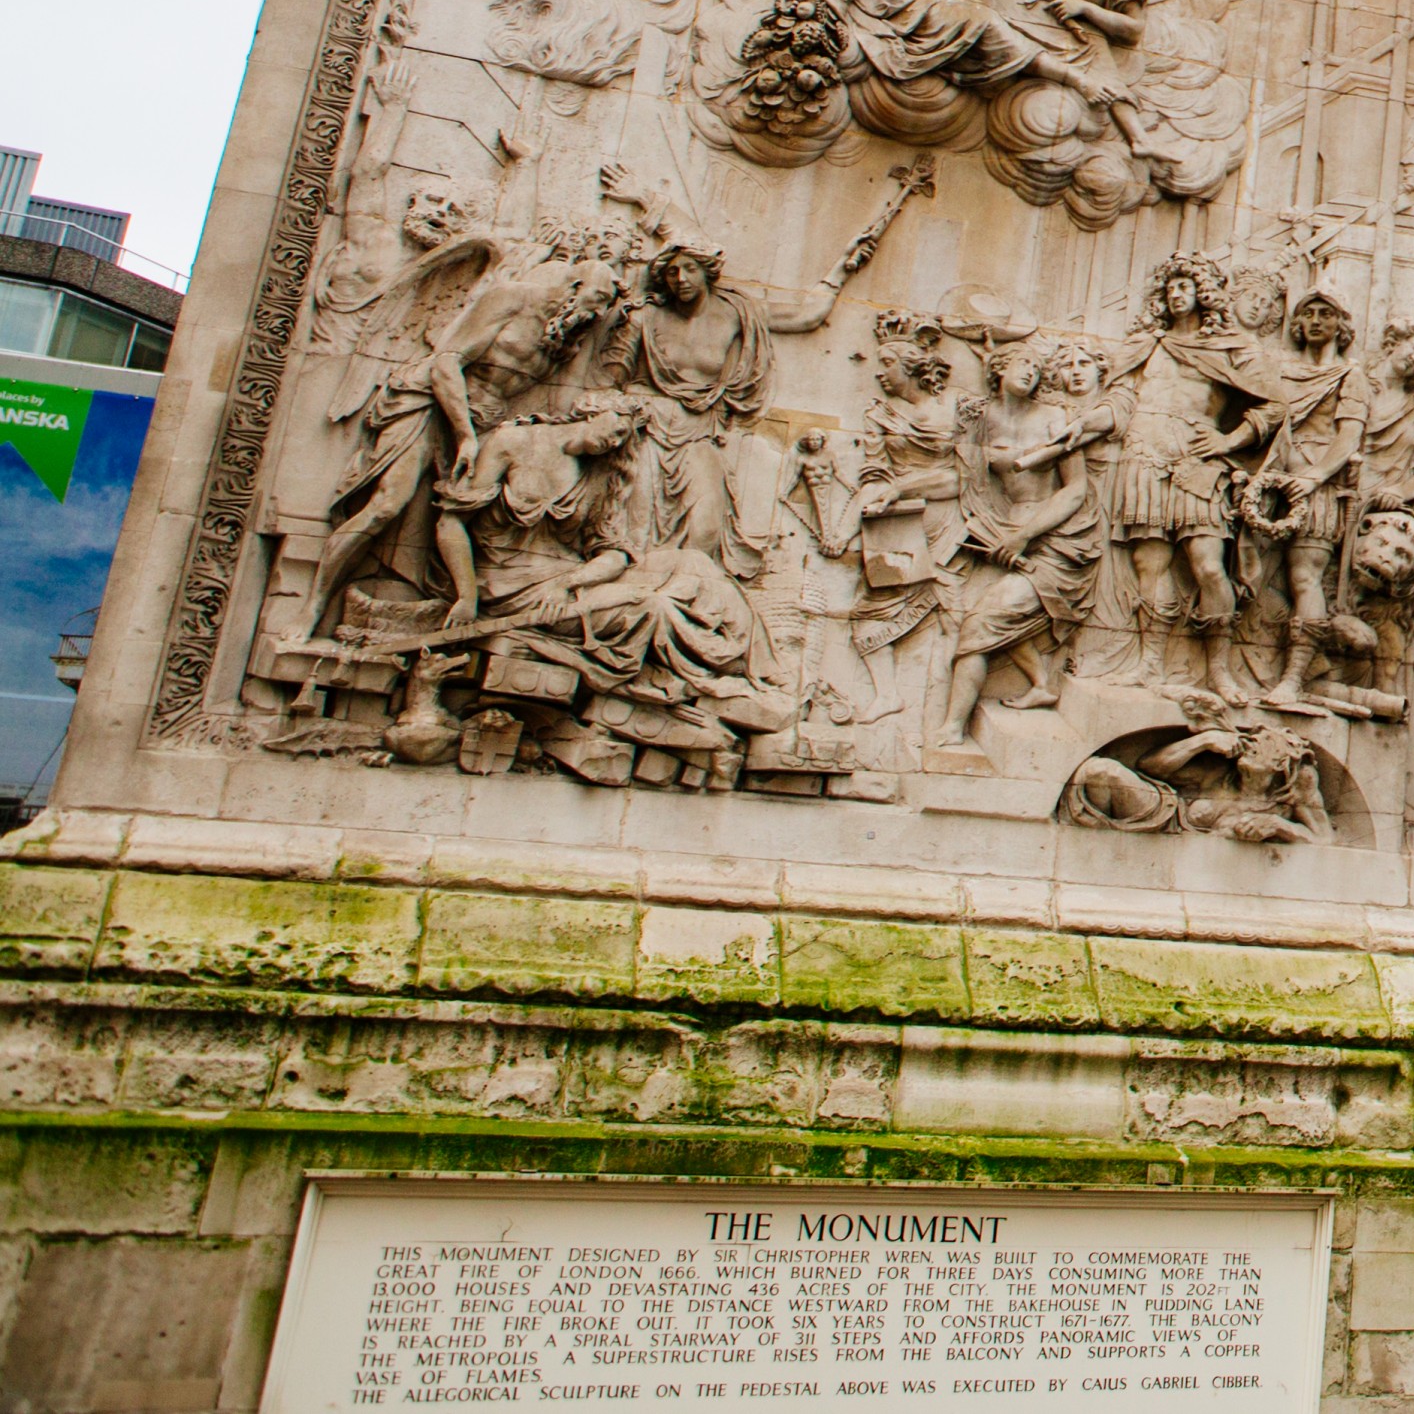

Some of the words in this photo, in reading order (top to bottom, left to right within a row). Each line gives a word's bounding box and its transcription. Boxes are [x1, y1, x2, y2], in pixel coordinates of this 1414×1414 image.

[30, 395, 45, 407] by
[706, 1212, 774, 1241] THE
[796, 1213, 1008, 1244] MONUMENT
[381, 1246, 422, 1261] THIS
[567, 1247, 661, 1263] DESIGNED
[675, 1249, 700, 1263] BY
[714, 1249, 738, 1263] SIR
[754, 1249, 870, 1264] CHRISTOPHER
[946, 1250, 981, 1265] WAS
[993, 1251, 1037, 1265] BUILT
[1052, 1251, 1074, 1265] TO
[1087, 1251, 1209, 1266] COMMEMORATE
[1223, 1252, 1251, 1265] THE
[375, 1264, 441, 1280] GREAT
[459, 1264, 500, 1279] FIRE
[517, 1264, 544, 1279] OF
[558, 1265, 643, 1280] LONDON
[715, 1265, 776, 1280] WHICH
[790, 1265, 863, 1281] BURNED
[877, 1266, 910, 1281] FOR
[926, 1266, 977, 1281] THREE
[992, 1266, 1034, 1281] DAYS
[1047, 1266, 1147, 1281] CONSUMING
[1160, 1267, 1205, 1281] MORE
[1218, 1267, 1262, 1281] THAN
[454, 1281, 531, 1296] HOUSES
[548, 1281, 592, 1296] AND
[607, 1281, 732, 1296] DEVASTATING
[747, 1282, 780, 1296] 436
[795, 1283, 851, 1297] ACRES
[866, 1283, 889, 1297] OF
[904, 1283, 935, 1297] THE
[1005, 1283, 1037, 1297] THE
[1050, 1283, 1148, 1297] MONUMENT
[1161, 1283, 1174, 1297] IS
[1243, 1283, 1259, 1296] IN
[459, 1299, 514, 1314] BEING
[527, 1298, 587, 1315] EQUAL
[601, 1298, 625, 1314] TO
[640, 1299, 675, 1314] THE
[687, 1298, 774, 1313] DISTANCE
[787, 1298, 889, 1314] WESTWARD
[902, 1299, 950, 1314] FROM
[964, 1298, 994, 1312] THE
[1008, 1298, 1101, 1312] BAKEHOUSE
[1111, 1298, 1127, 1311] IN
[1145, 1298, 1213, 1312] PUDDING
[1224, 1298, 1265, 1311] LANE
[366, 1317, 433, 1333] WHERE
[450, 1316, 486, 1332] THE
[502, 1315, 543, 1332] FIRE
[559, 1316, 621, 1332] BROKE
[695, 1315, 713, 1330] IT
[726, 1315, 775, 1330] TOOK
[791, 1315, 818, 1330] SIX
[832, 1315, 886, 1330] YEARS
[904, 1314, 925, 1329] TO
[940, 1314, 1046, 1329] CONSTRUCT
[1149, 1313, 1178, 1327] THE
[1191, 1313, 1264, 1327] BALCONY
[361, 1334, 378, 1350] IS
[396, 1334, 487, 1350] REACHED
[503, 1334, 528, 1348] BY
[543, 1333, 557, 1348] A
[572, 1333, 633, 1348] SPIRAL
[649, 1332, 742, 1348] STAIRWAY
[757, 1331, 781, 1346] OF
[795, 1331, 816, 1347] 311
[830, 1331, 882, 1346] STEPS
[899, 1331, 937, 1345] AND
[950, 1331, 1025, 1345] AFFORDS
[1040, 1329, 1136, 1345] PANORAMIC
[1152, 1329, 1202, 1343] VIEWS
[1216, 1329, 1239, 1342] OF
[359, 1352, 397, 1368] THE
[414, 1350, 539, 1368] METROPOLIS
[562, 1350, 576, 1365] A
[591, 1348, 756, 1366] SUPERSTRUCTURE
[772, 1347, 819, 1363] RISES
[835, 1347, 885, 1362] FROM
[900, 1347, 932, 1361] THE
[945, 1346, 1025, 1362] BALCONY
[1036, 1346, 1072, 1360] AND
[1087, 1345, 1166, 1360] SUPPORTS
[1180, 1345, 1191, 1358] A
[1203, 1343, 1260, 1358] COPPER
[354, 1370, 402, 1386] VASE
[419, 1370, 448, 1386] OF
[352, 1389, 387, 1405] THE
[402, 1386, 521, 1404] ALLEGORICAL
[539, 1384, 641, 1401] SCULPTURE
[655, 1384, 682, 1399] ON
[696, 1383, 728, 1398] THE
[740, 1381, 821, 1397] PEDESTAL
[836, 1380, 889, 1396] ABOVE
[902, 1379, 936, 1394] WAS
[953, 1378, 1036, 1394] EXECUTED
[1048, 1378, 1069, 1393] BY
[1081, 1377, 1128, 1392] CAIUS
[1140, 1375, 1201, 1390] GABRIEL
